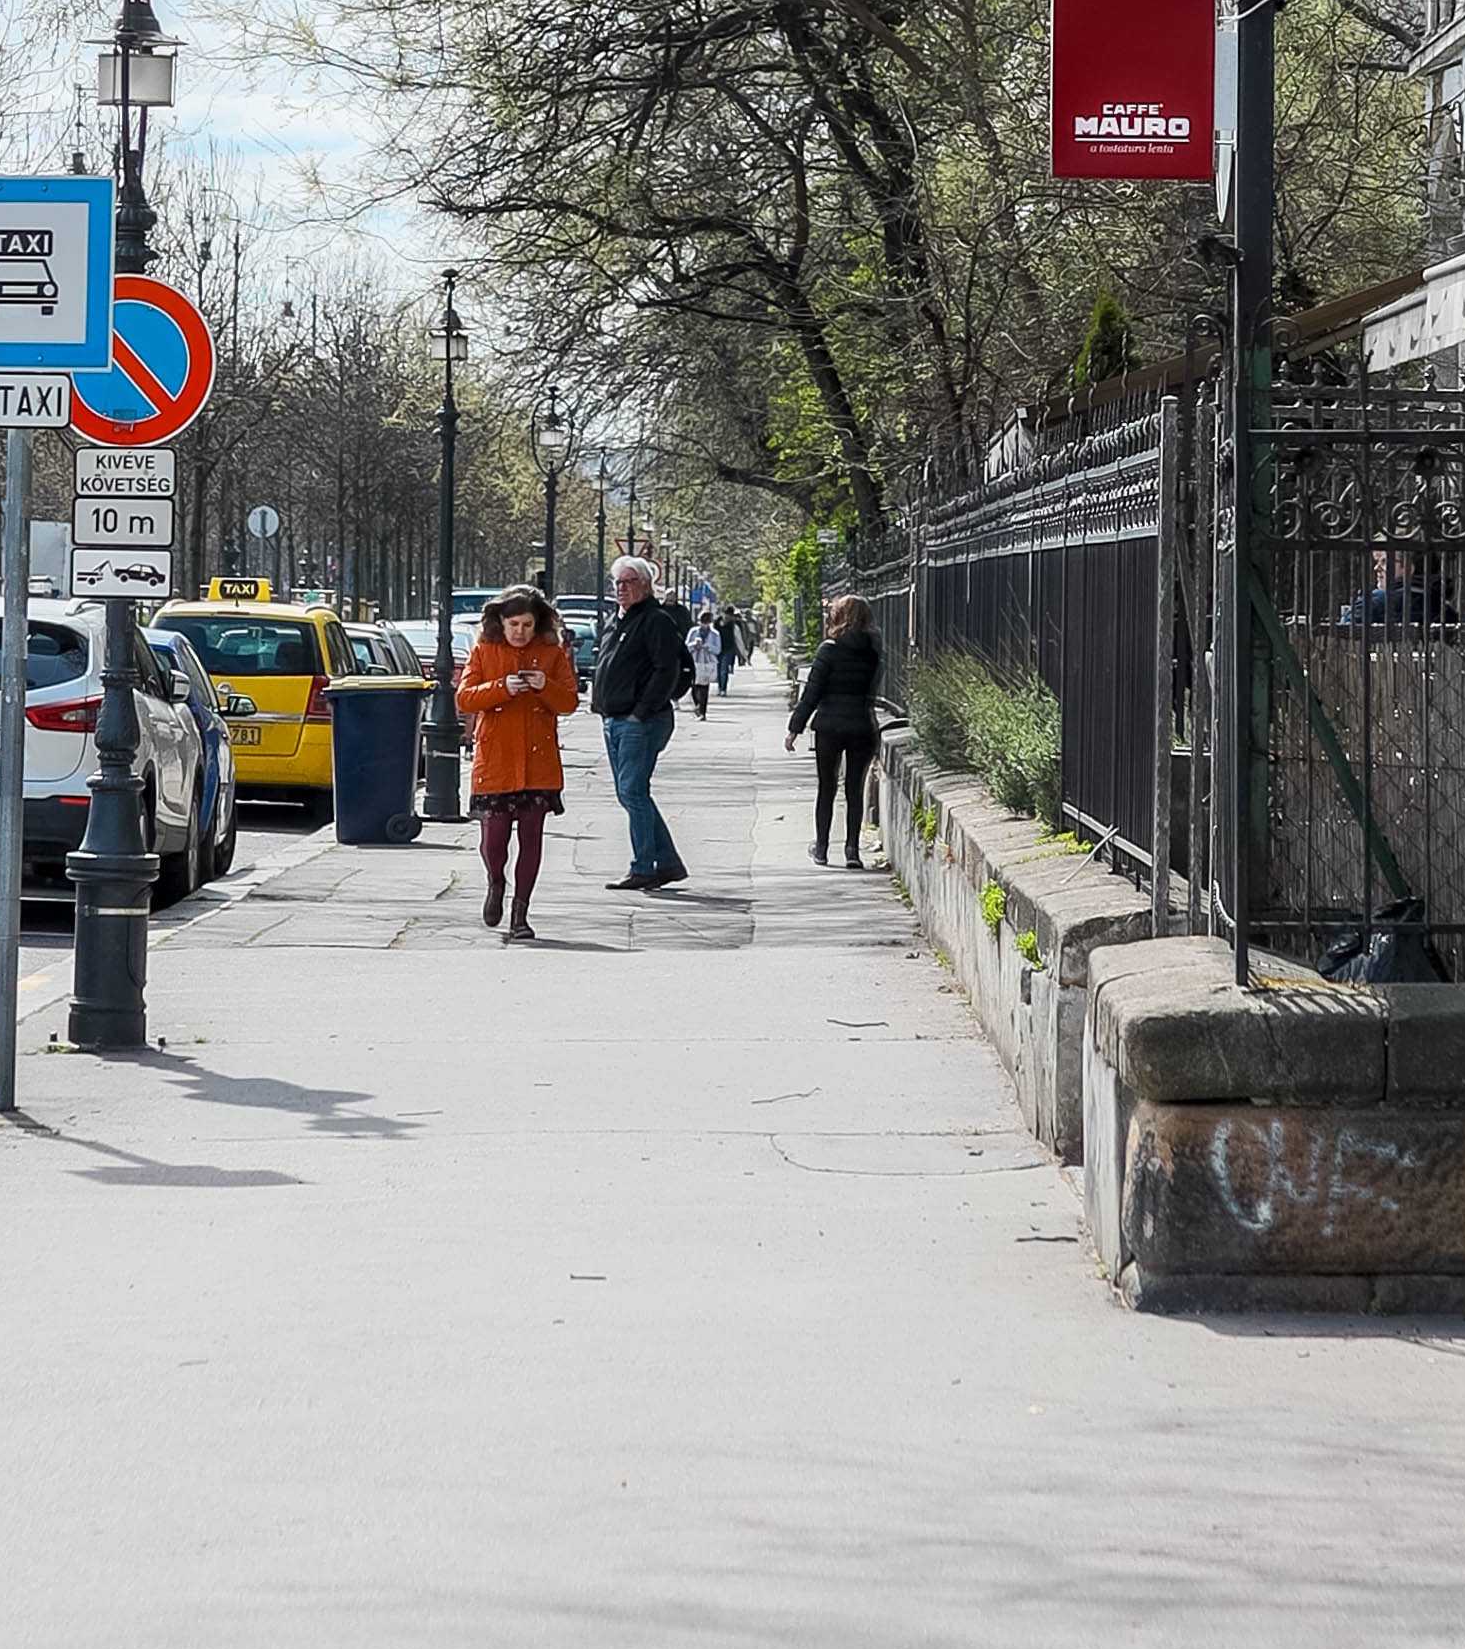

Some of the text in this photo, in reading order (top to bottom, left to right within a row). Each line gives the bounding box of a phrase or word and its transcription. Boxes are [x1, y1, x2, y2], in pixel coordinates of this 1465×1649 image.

[1074, 116, 1190, 137] MAURO
[1089, 142, 1174, 154] a tostatura lenta
[95, 452, 156, 470] KIVÉVE
[80, 474, 171, 493] KÖVETSÉG
[91, 507, 155, 535] 10 m
[222, 583, 256, 595] TAXI
